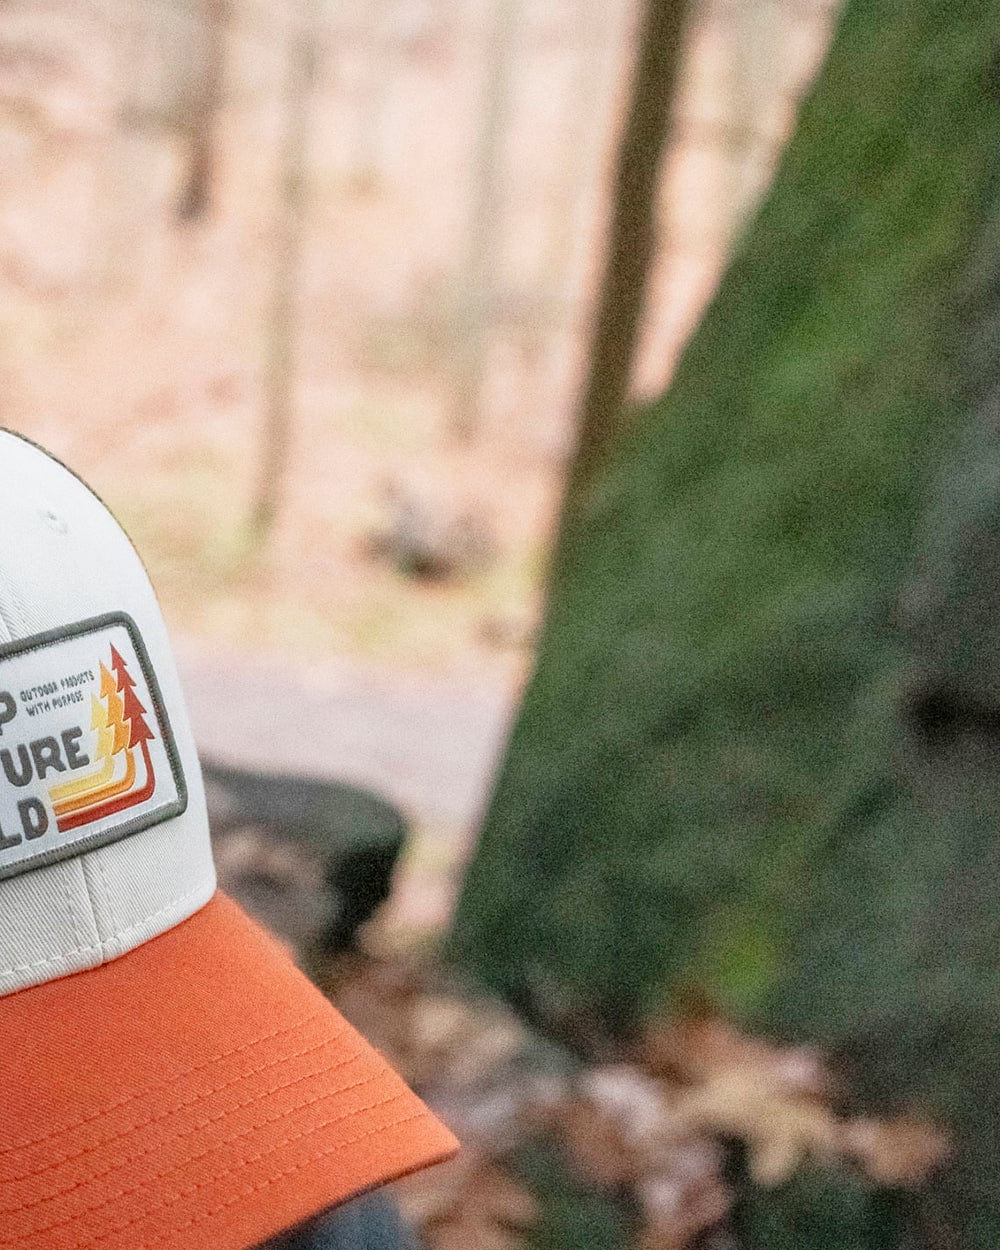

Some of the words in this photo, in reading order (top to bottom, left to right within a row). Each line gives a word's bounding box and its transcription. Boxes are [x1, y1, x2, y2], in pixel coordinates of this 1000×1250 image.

[20, 682, 58, 702] OUTDOOR
[61, 670, 94, 690] PRODUCTS
[26, 702, 51, 716] WITH
[52, 690, 84, 710] PURPOSE
